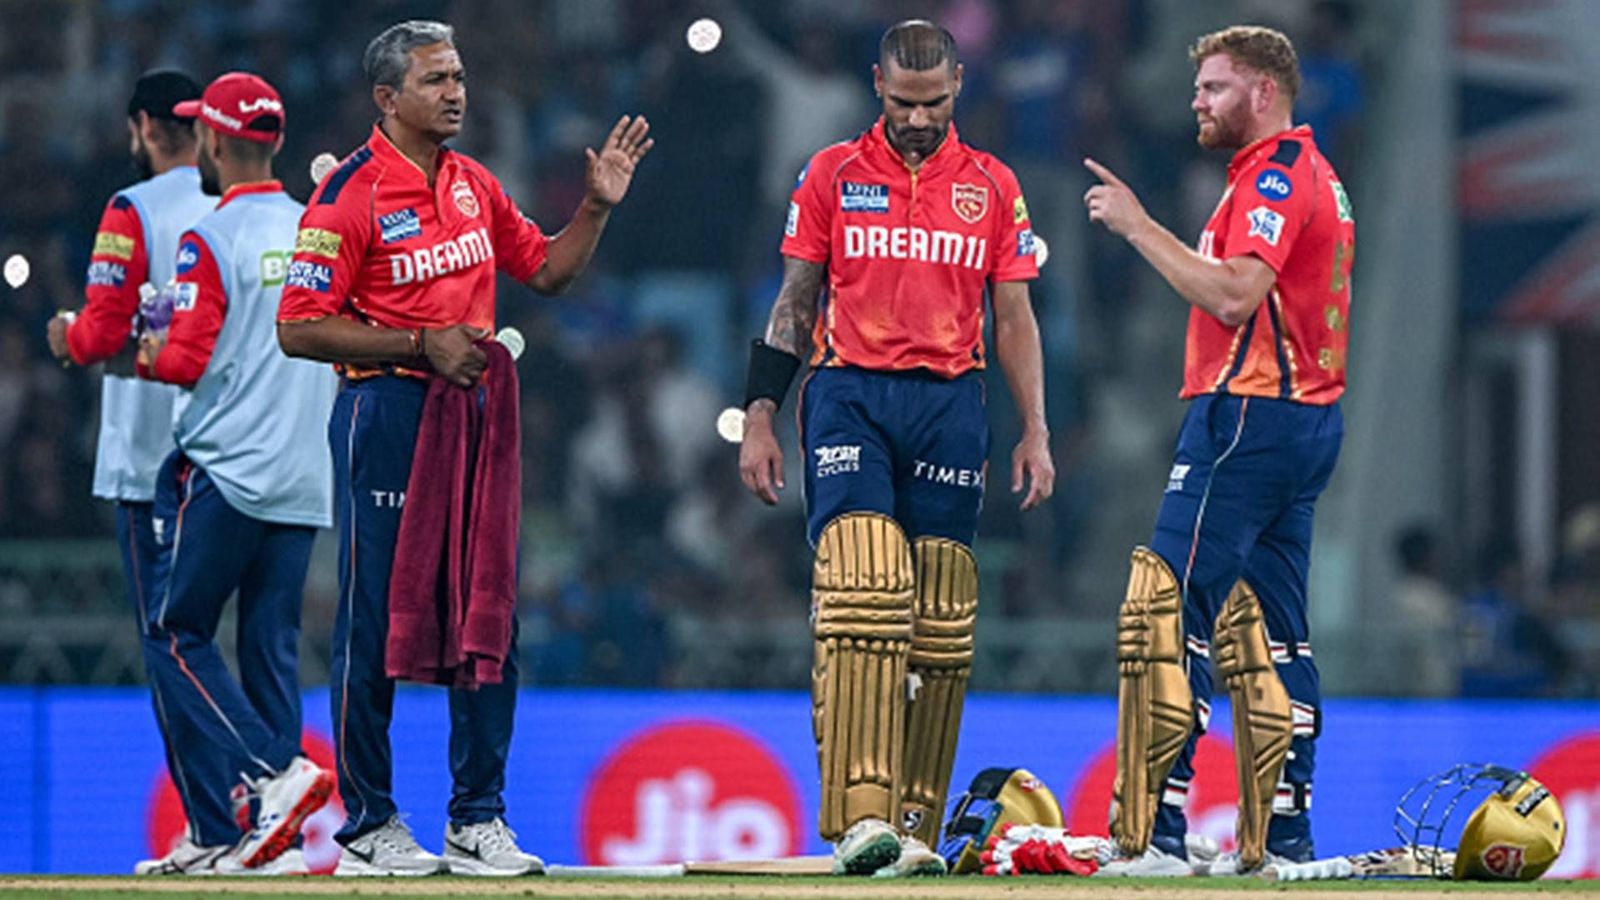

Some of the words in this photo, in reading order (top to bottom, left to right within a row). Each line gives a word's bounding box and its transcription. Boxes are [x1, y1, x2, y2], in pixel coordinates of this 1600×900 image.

[1258, 175, 1290, 195] Jio
[844, 225, 986, 269] DREAM11
[602, 767, 790, 866] Jio
